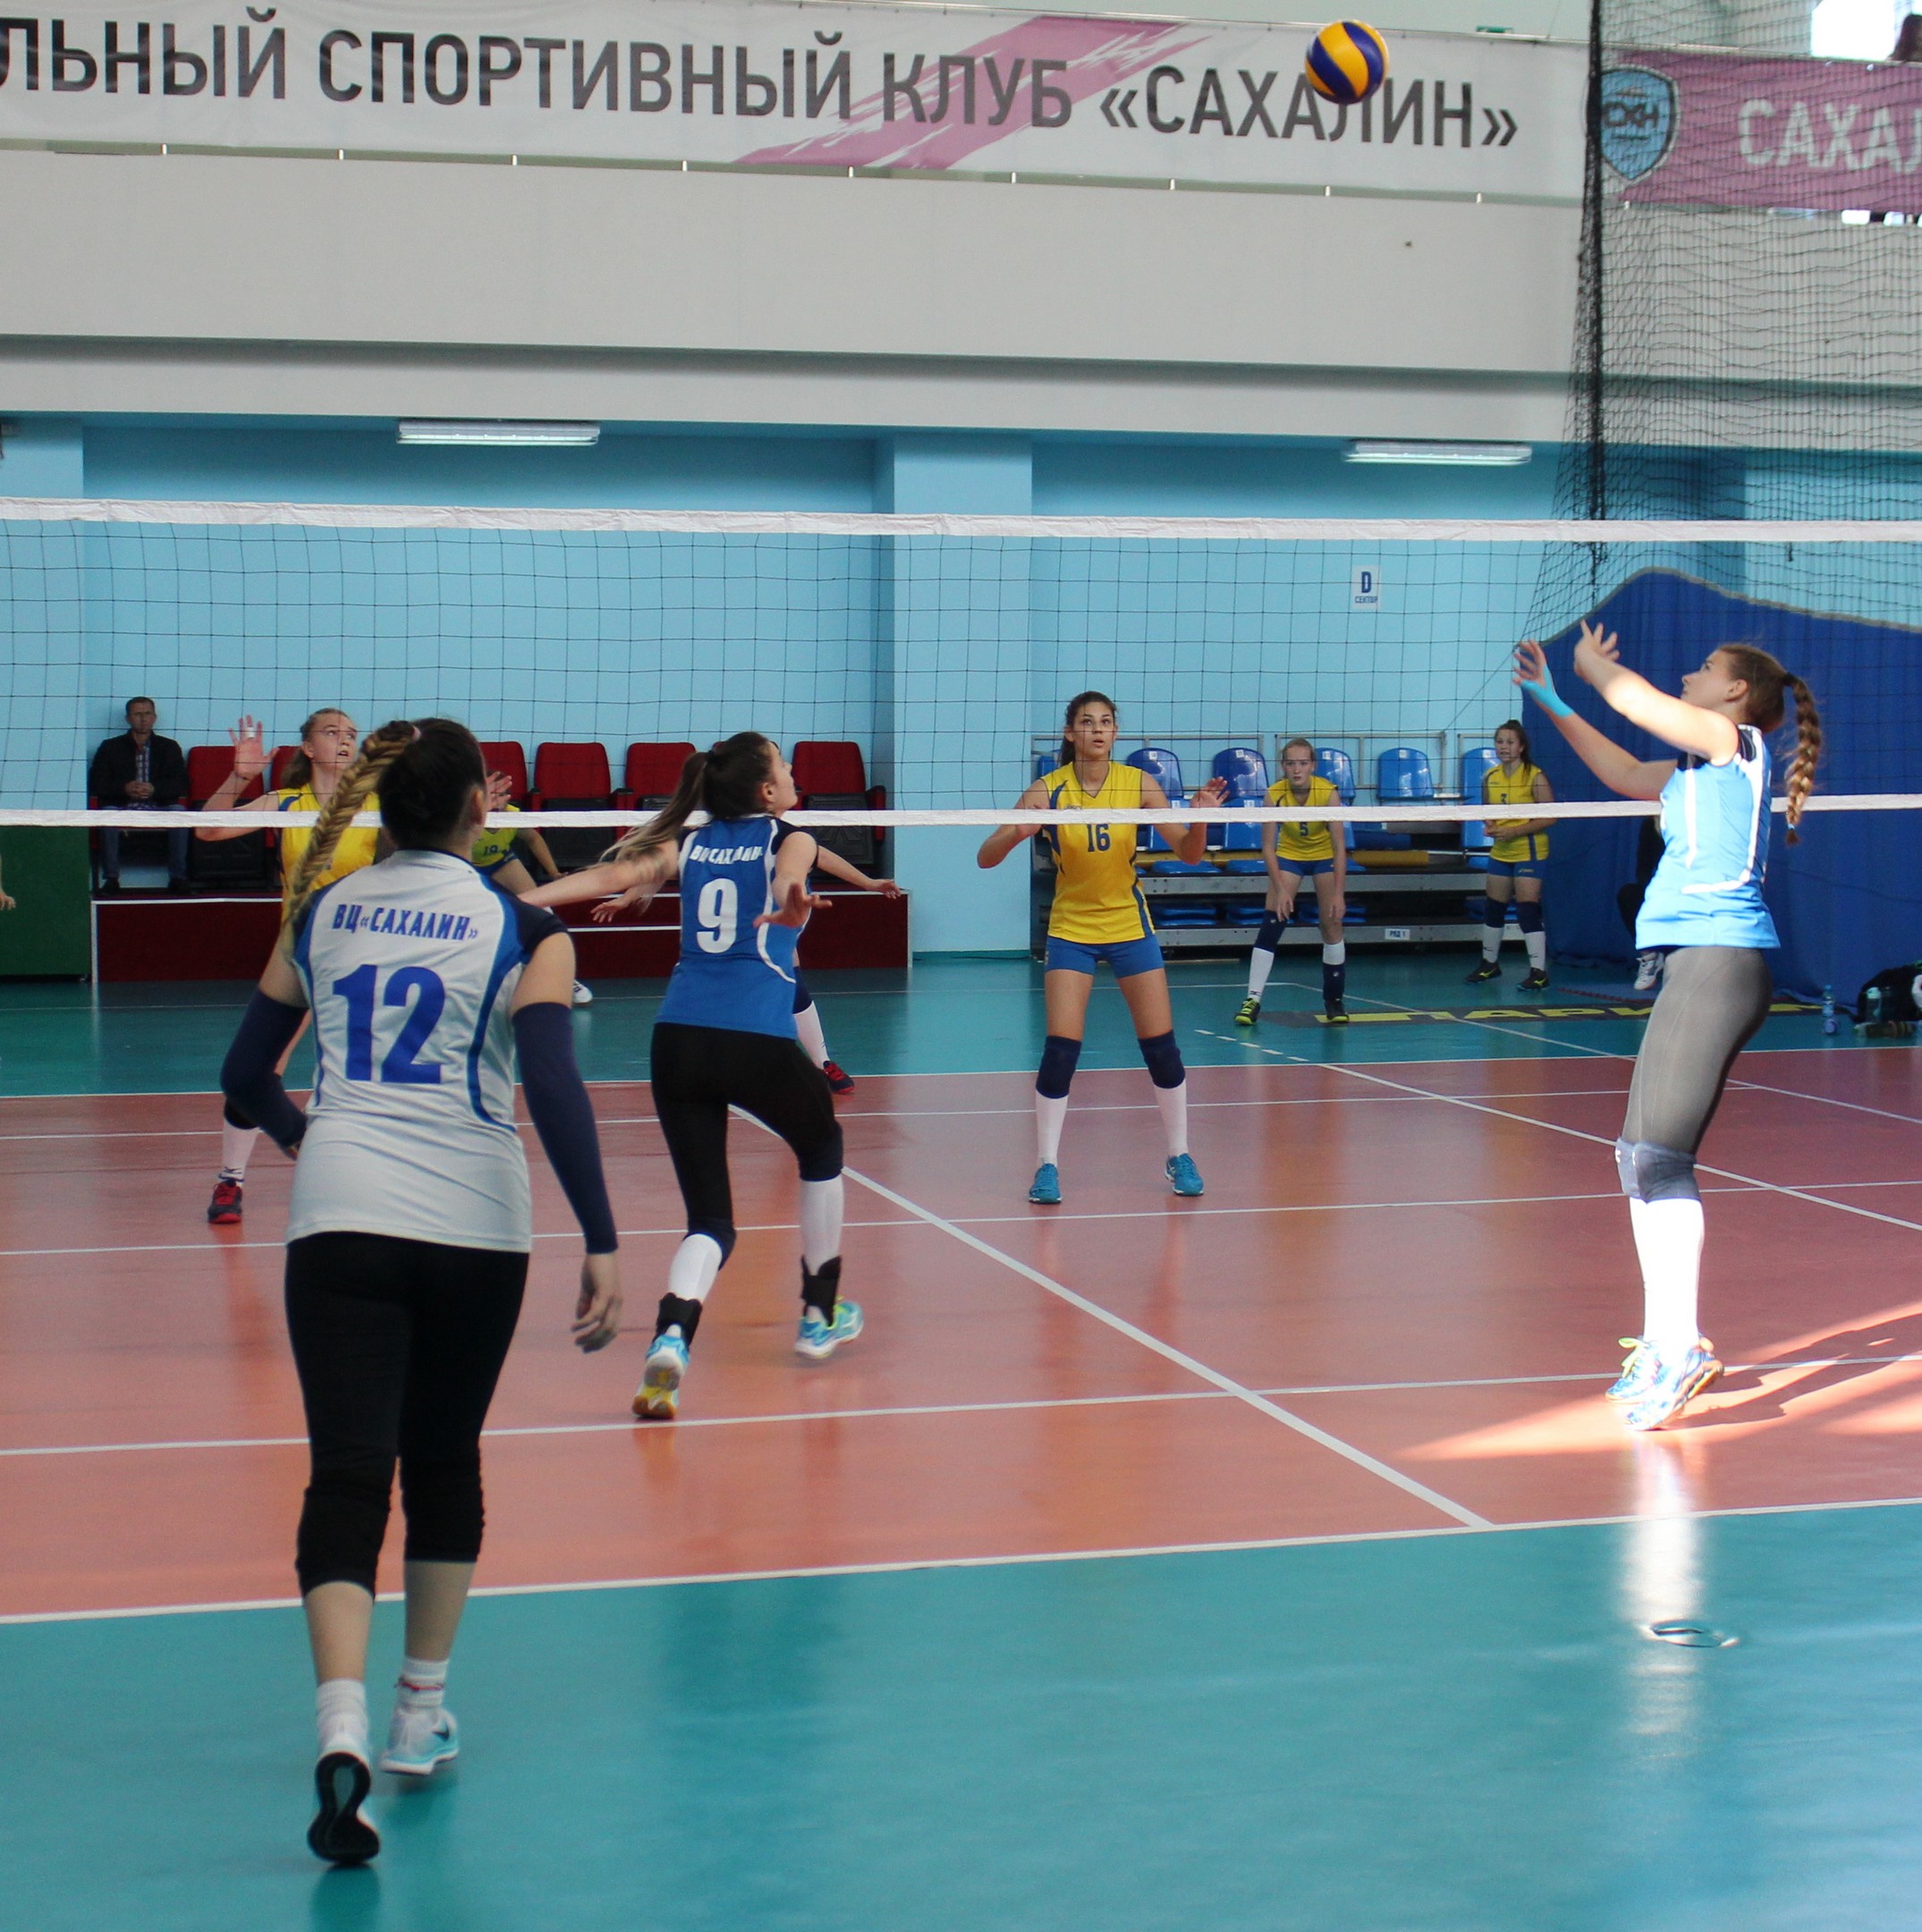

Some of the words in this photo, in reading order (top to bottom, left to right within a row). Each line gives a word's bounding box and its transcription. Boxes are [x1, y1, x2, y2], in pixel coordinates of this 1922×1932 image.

[318, 30, 851, 120] СПОРТИВНЫЙ
[883, 52, 1072, 128] КЛУБ
[1361, 571, 1372, 593] D
[1087, 823, 1111, 852] 16
[696, 877, 738, 954] 9
[332, 963, 446, 1084] 12
